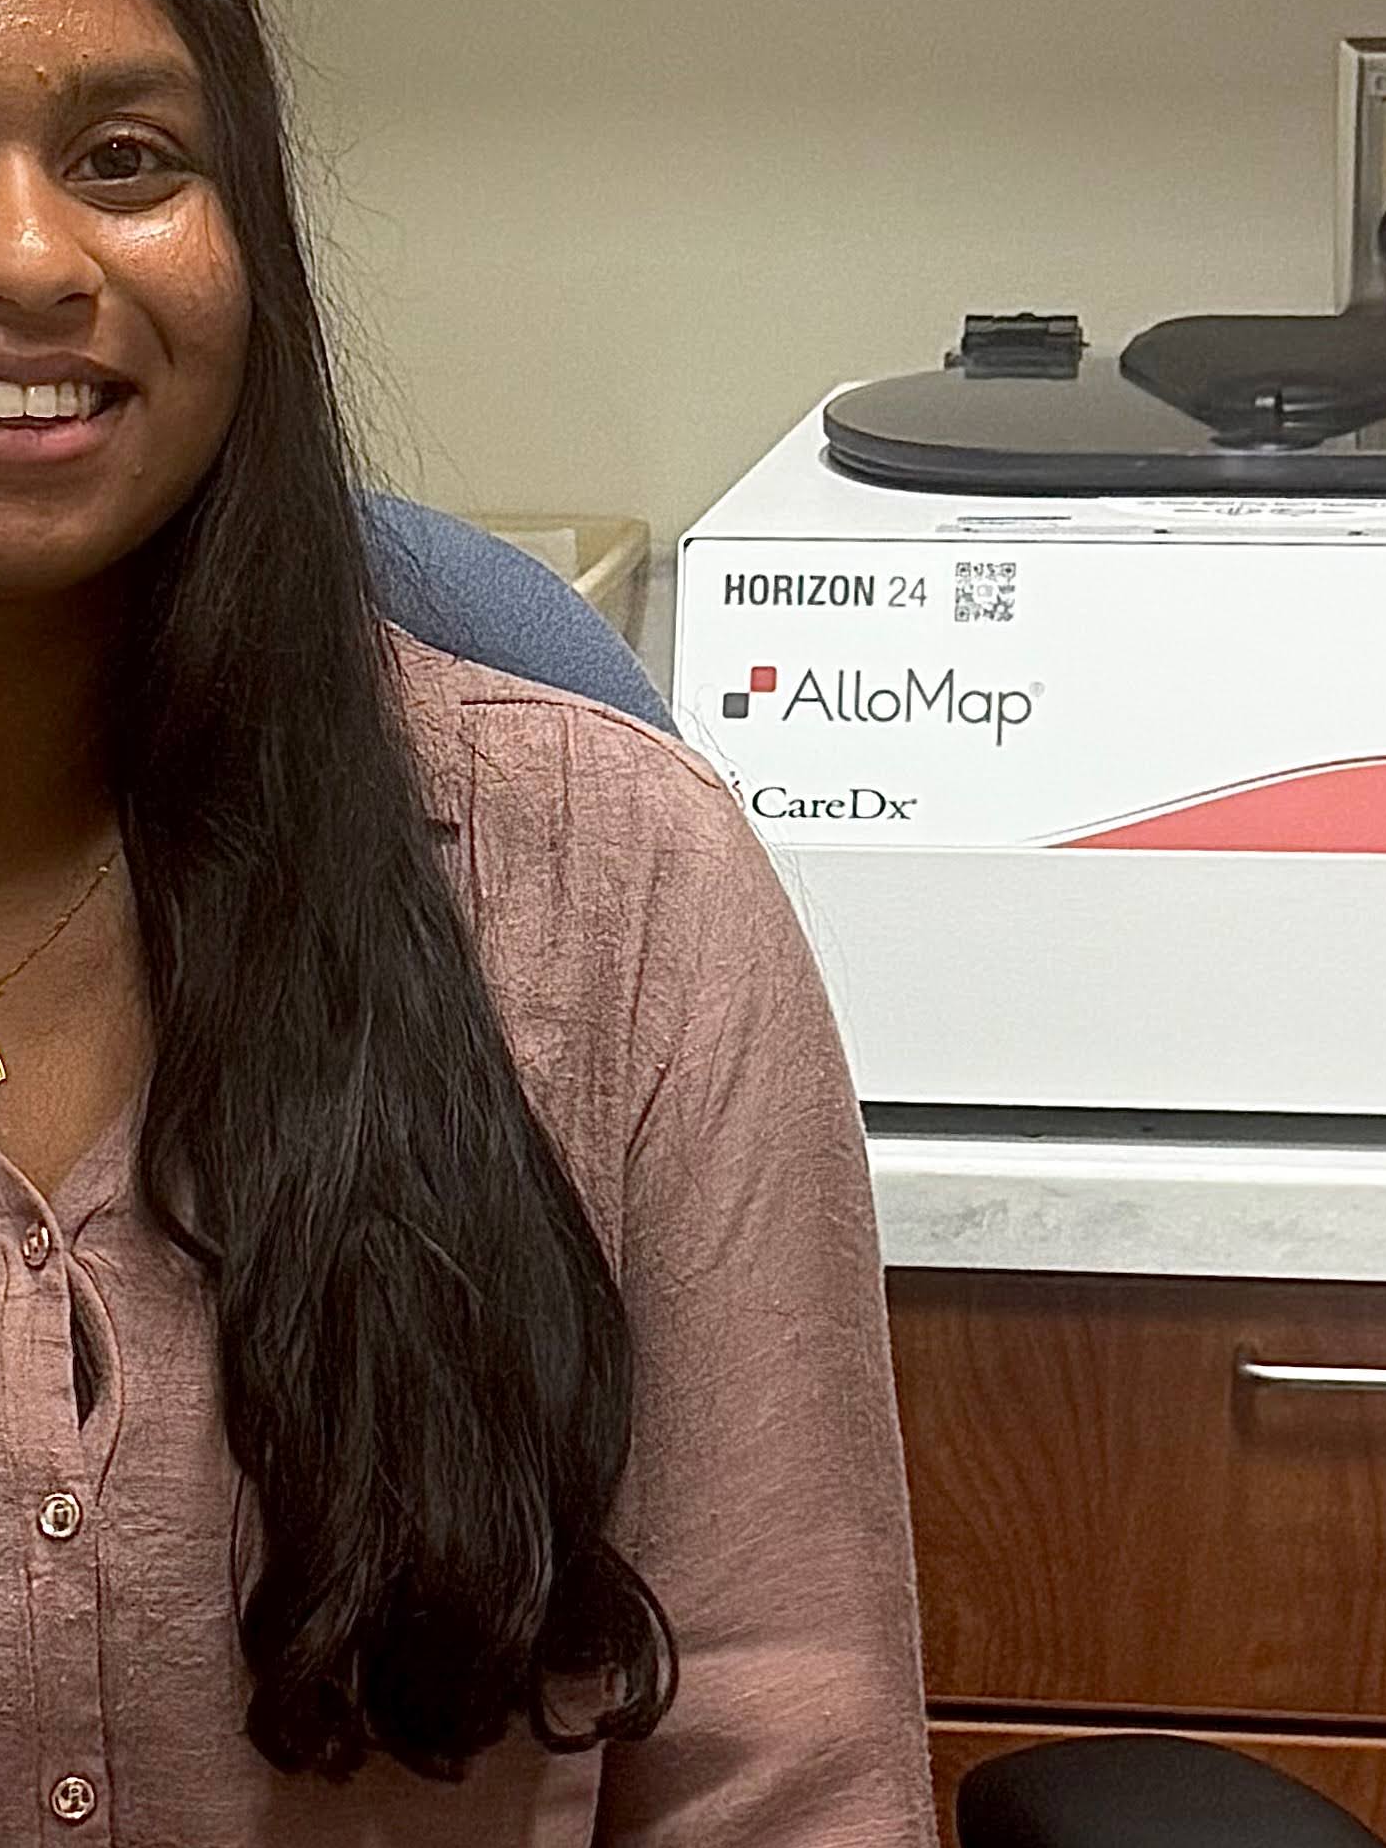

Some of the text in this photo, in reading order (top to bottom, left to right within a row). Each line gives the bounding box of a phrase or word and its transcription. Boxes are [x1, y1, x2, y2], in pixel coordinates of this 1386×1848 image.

[723, 574, 927, 608] HORIZON 24
[751, 787, 914, 820] CareDx
